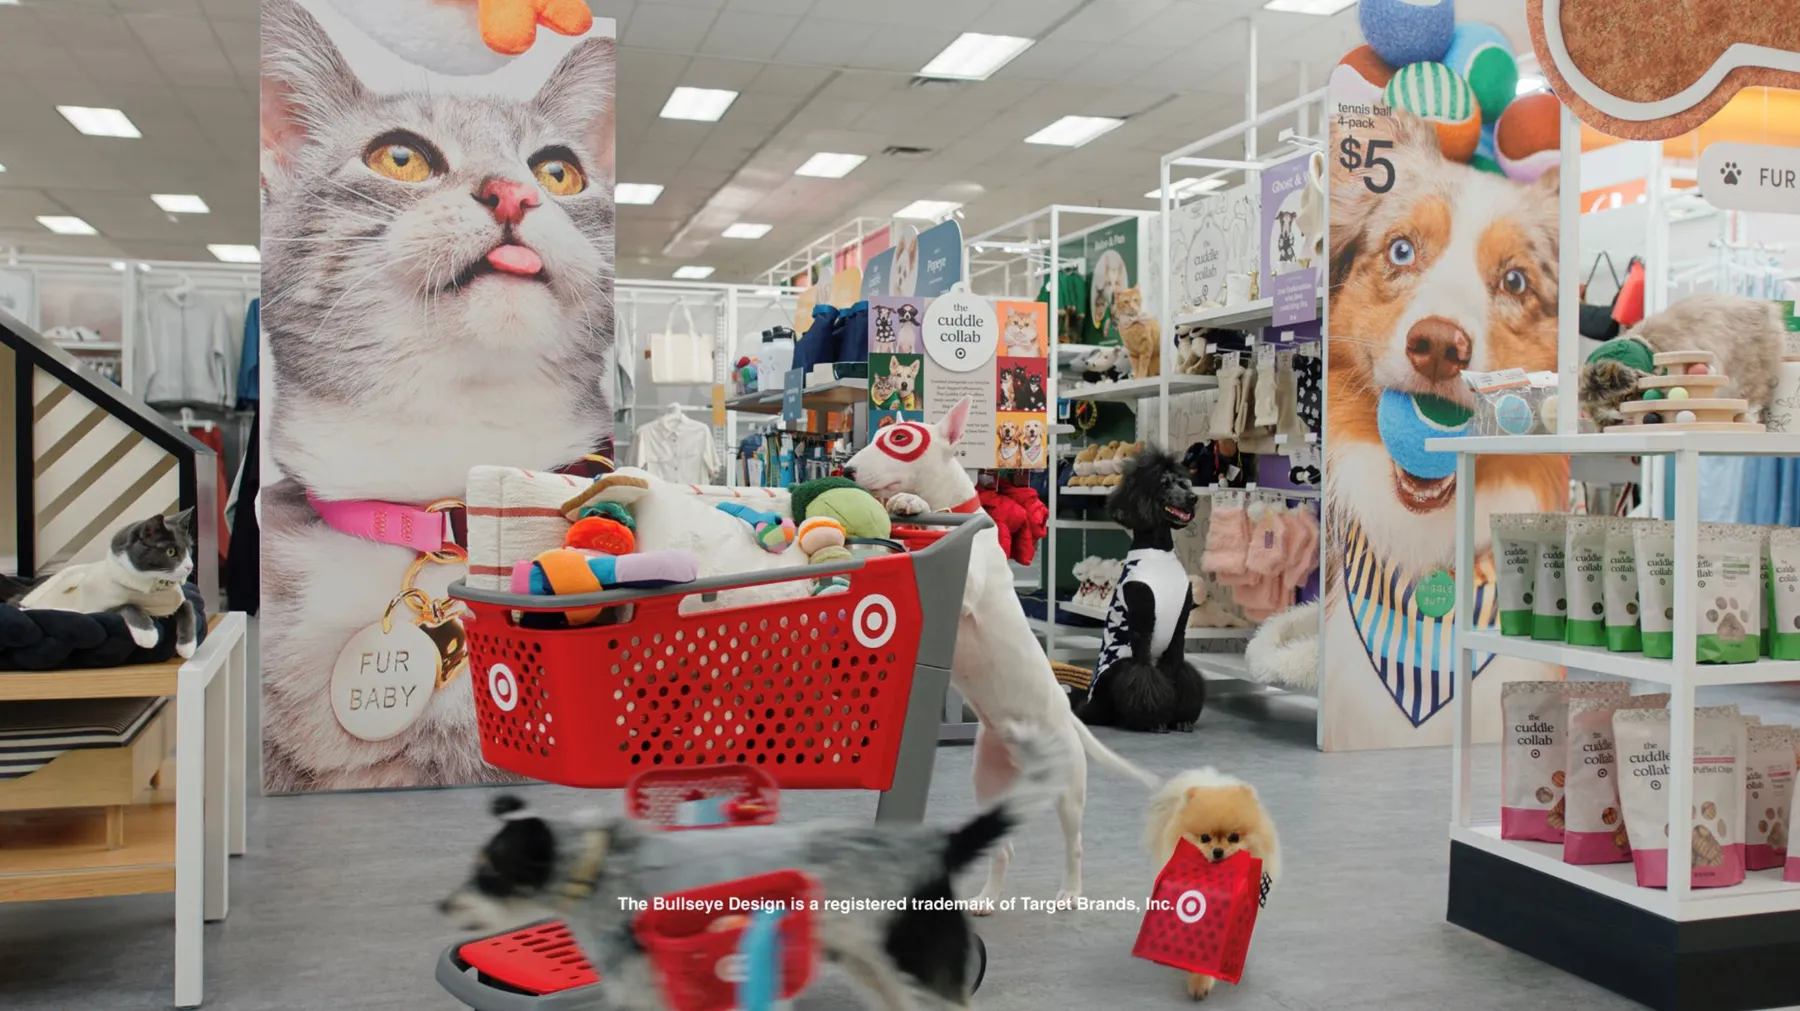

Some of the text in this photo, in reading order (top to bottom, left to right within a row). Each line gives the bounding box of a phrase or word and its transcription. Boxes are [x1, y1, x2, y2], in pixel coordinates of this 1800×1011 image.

[1338, 102, 1392, 117] tennis ball
[1338, 115, 1375, 129] 4-pack
[1340, 135, 1396, 194] $5
[1760, 167, 1796, 188] FUR
[1272, 178, 1294, 194] Ghost
[1294, 173, 1302, 186] &
[1194, 249, 1218, 265] cuddle
[1195, 264, 1217, 281] collab
[953, 303, 968, 311] the
[937, 314, 984, 327] cuddle
[940, 330, 981, 343] collab
[1504, 548, 1528, 556] cuddle
[1575, 553, 1602, 562] cuddle
[1507, 557, 1529, 565] collab
[1610, 556, 1634, 564] cuddle
[1647, 558, 1674, 567] cuddle
[1577, 563, 1602, 572] collab
[1611, 564, 1634, 573] collab
[1650, 567, 1674, 576] collab
[360, 650, 410, 675] FUR
[349, 685, 417, 711] BABY
[1528, 713, 1540, 721] the
[1515, 722, 1554, 733] cuddle
[1517, 735, 1553, 746] collab
[1583, 740, 1613, 752] cuddle
[1643, 742, 1658, 750] the
[1584, 753, 1614, 765] collab
[1629, 750, 1671, 763] cuddle
[1746, 781, 1764, 789] ollab
